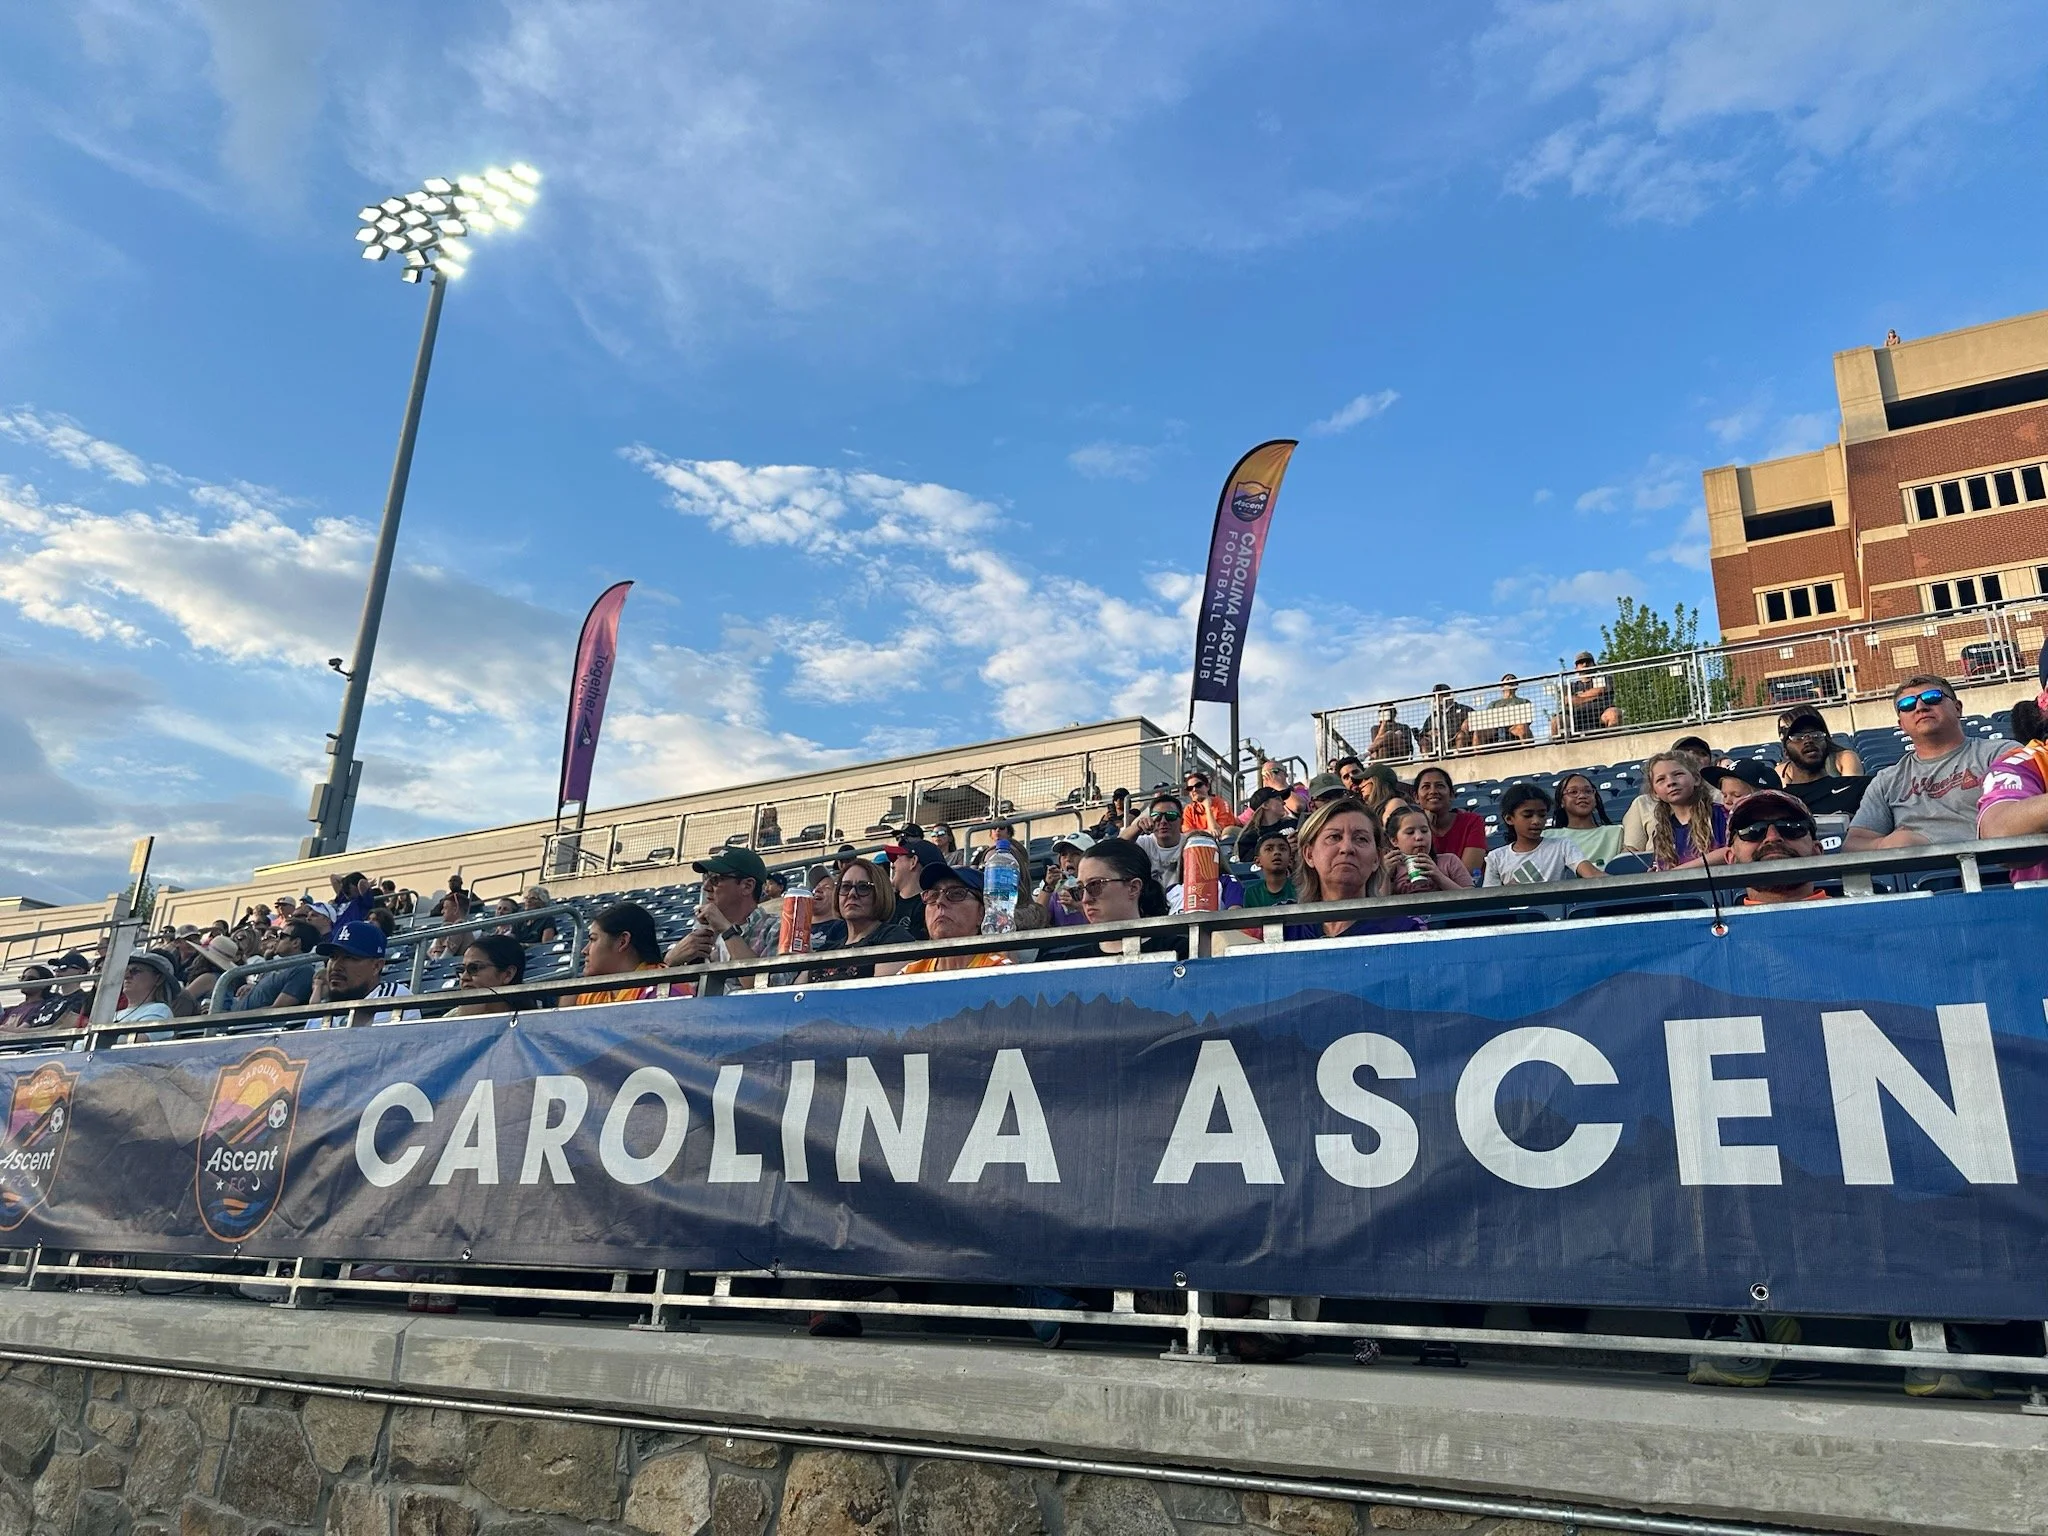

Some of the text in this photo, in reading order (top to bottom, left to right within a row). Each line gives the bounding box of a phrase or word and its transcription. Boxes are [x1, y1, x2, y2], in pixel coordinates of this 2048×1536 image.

[1234, 499, 1264, 510] Ascent
[1199, 531, 1238, 680] FOOTBALL CLUB
[1213, 532, 1256, 687] CAROLINA ASCENT
[585, 655, 609, 716] Together
[1824, 839, 1836, 847] 11
[338, 925, 351, 941] LA
[355, 999, 2048, 1190] CAROLINA ASCEN
[0, 1147, 56, 1170] Ascent
[205, 1146, 278, 1172] Ascent
